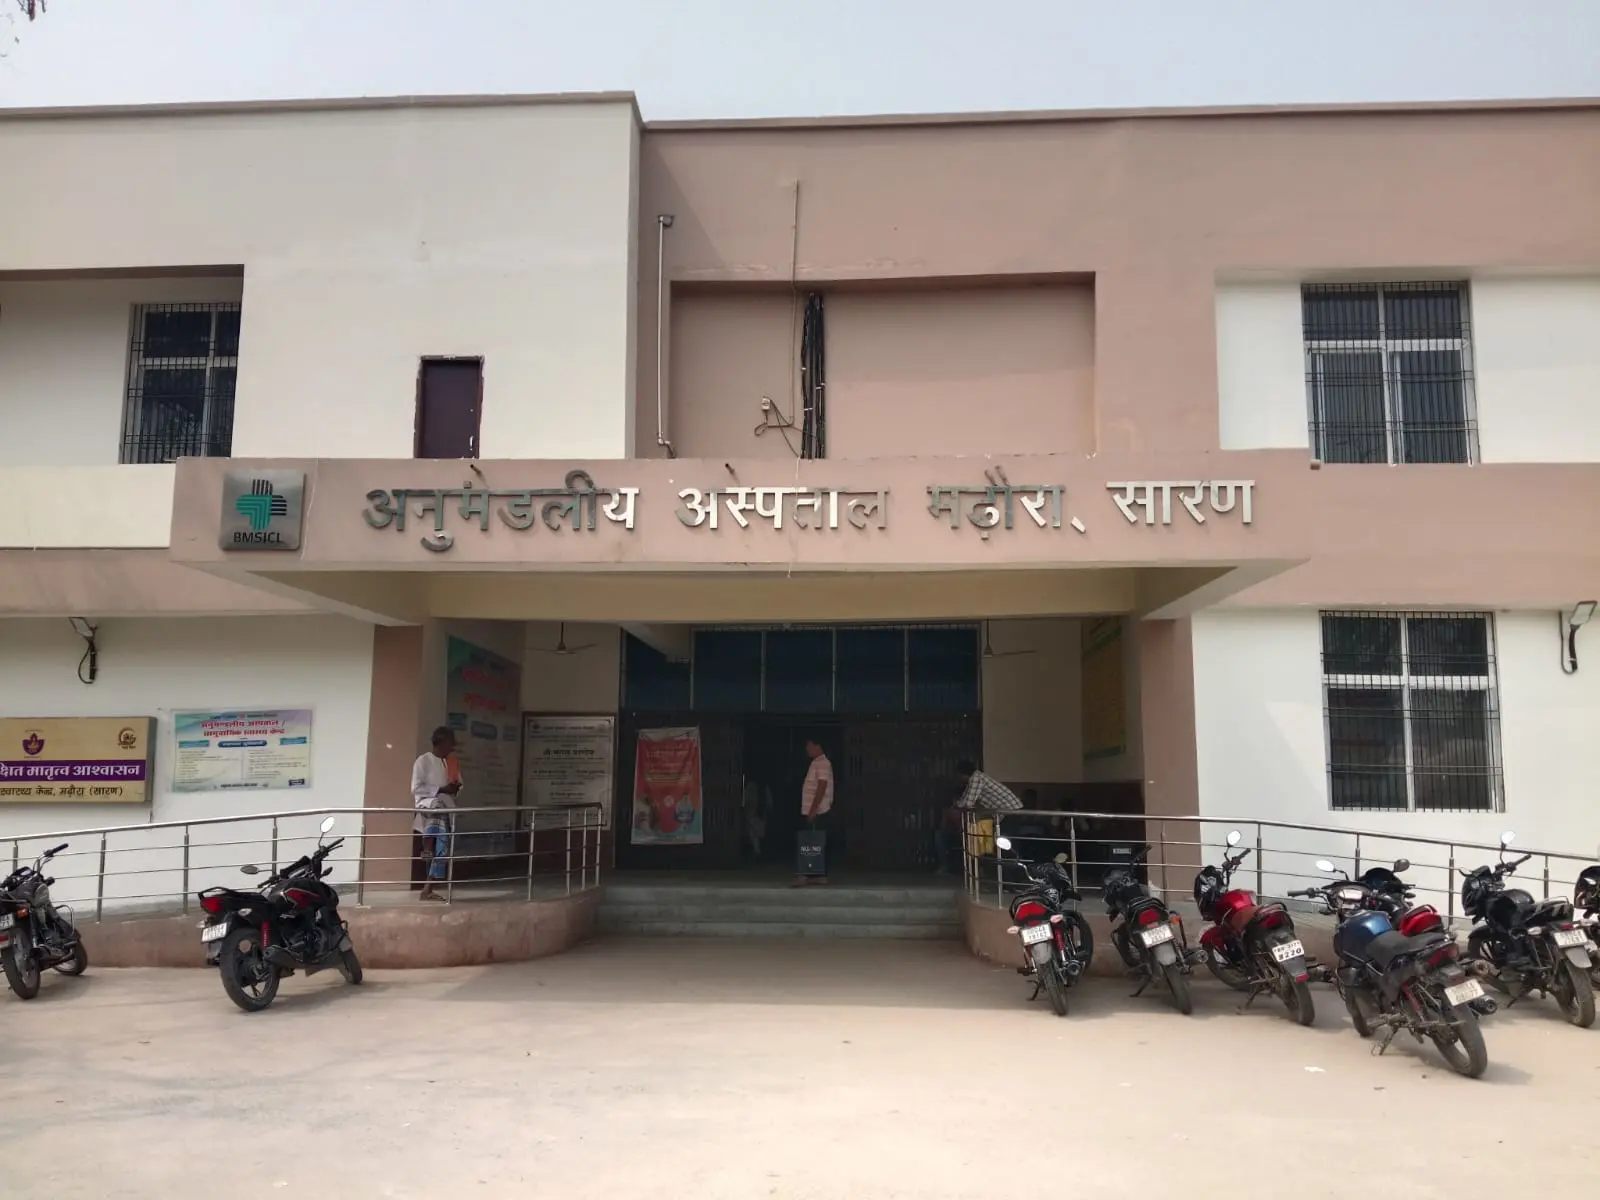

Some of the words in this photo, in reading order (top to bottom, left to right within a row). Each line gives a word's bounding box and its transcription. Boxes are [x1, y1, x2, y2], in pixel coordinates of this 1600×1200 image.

[362, 470, 640, 552] अनुमंडलीय
[675, 486, 890, 530] अस्पताल
[1106, 480, 1256, 525] सारण
[233, 531, 285, 544] BMSICL
[26, 765, 70, 780] मातृत्व
[72, 765, 140, 776] आश्वासन
